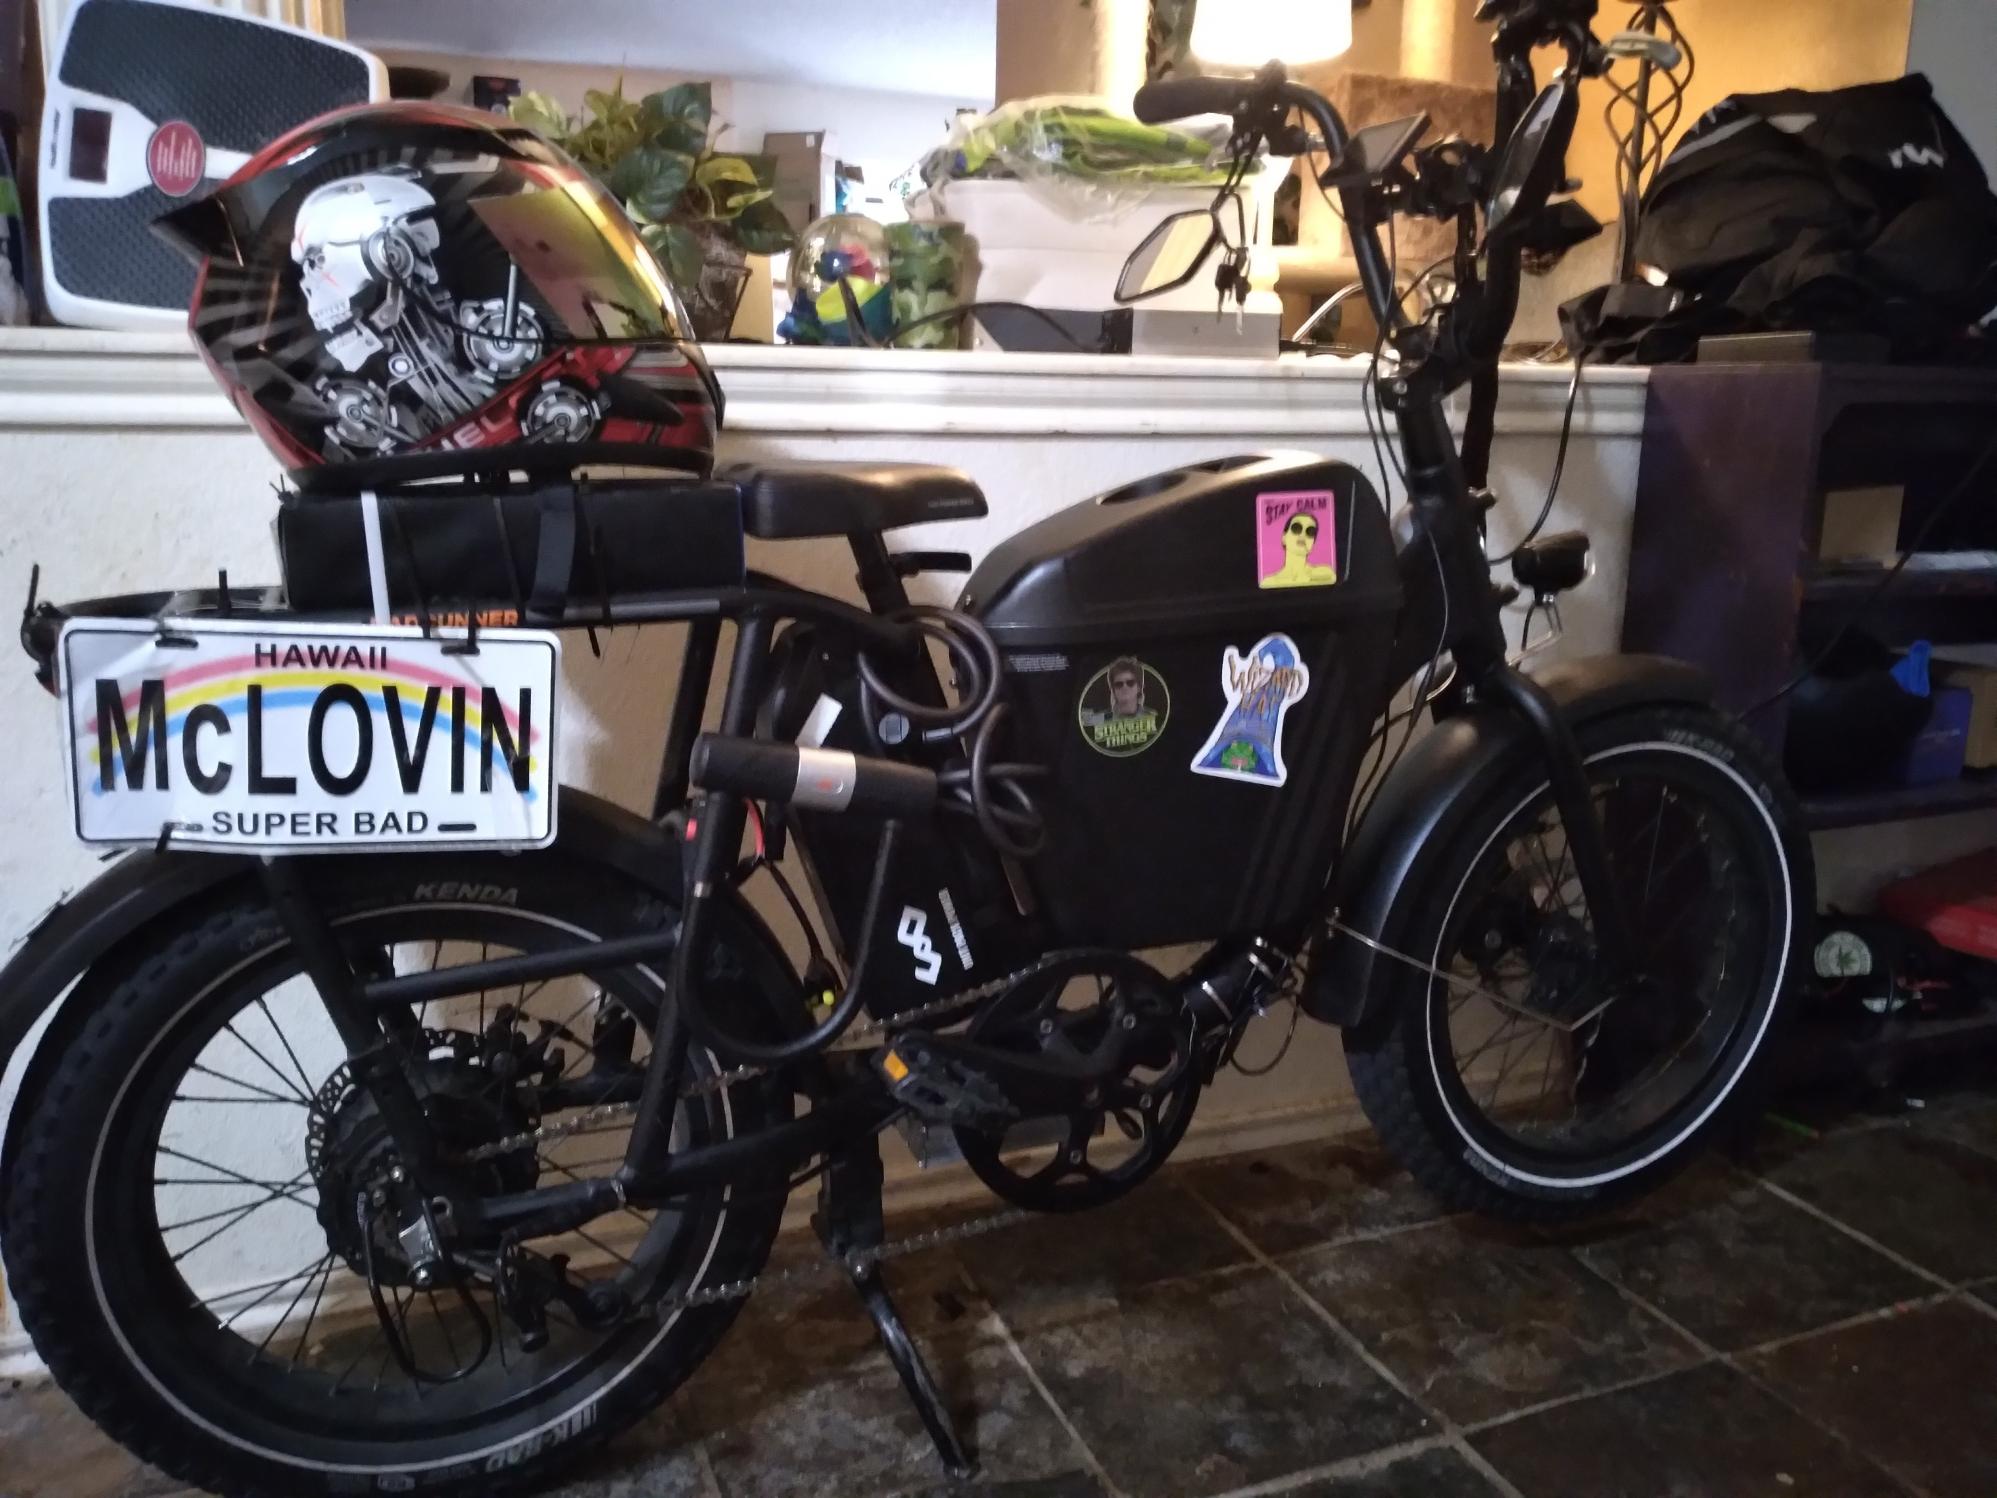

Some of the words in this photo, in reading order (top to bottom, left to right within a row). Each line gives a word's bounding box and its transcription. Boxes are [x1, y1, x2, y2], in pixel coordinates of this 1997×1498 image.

[1265, 502, 1292, 525] STAY
[1296, 497, 1327, 512] CALM
[254, 643, 389, 671] HAWAII
[95, 677, 533, 796] McLOVIN
[1094, 714, 1158, 743] STRANGER
[1105, 732, 1148, 748] THINGS
[212, 811, 339, 837] SUPER
[353, 811, 430, 836] BAD
[413, 881, 519, 906] KENDA
